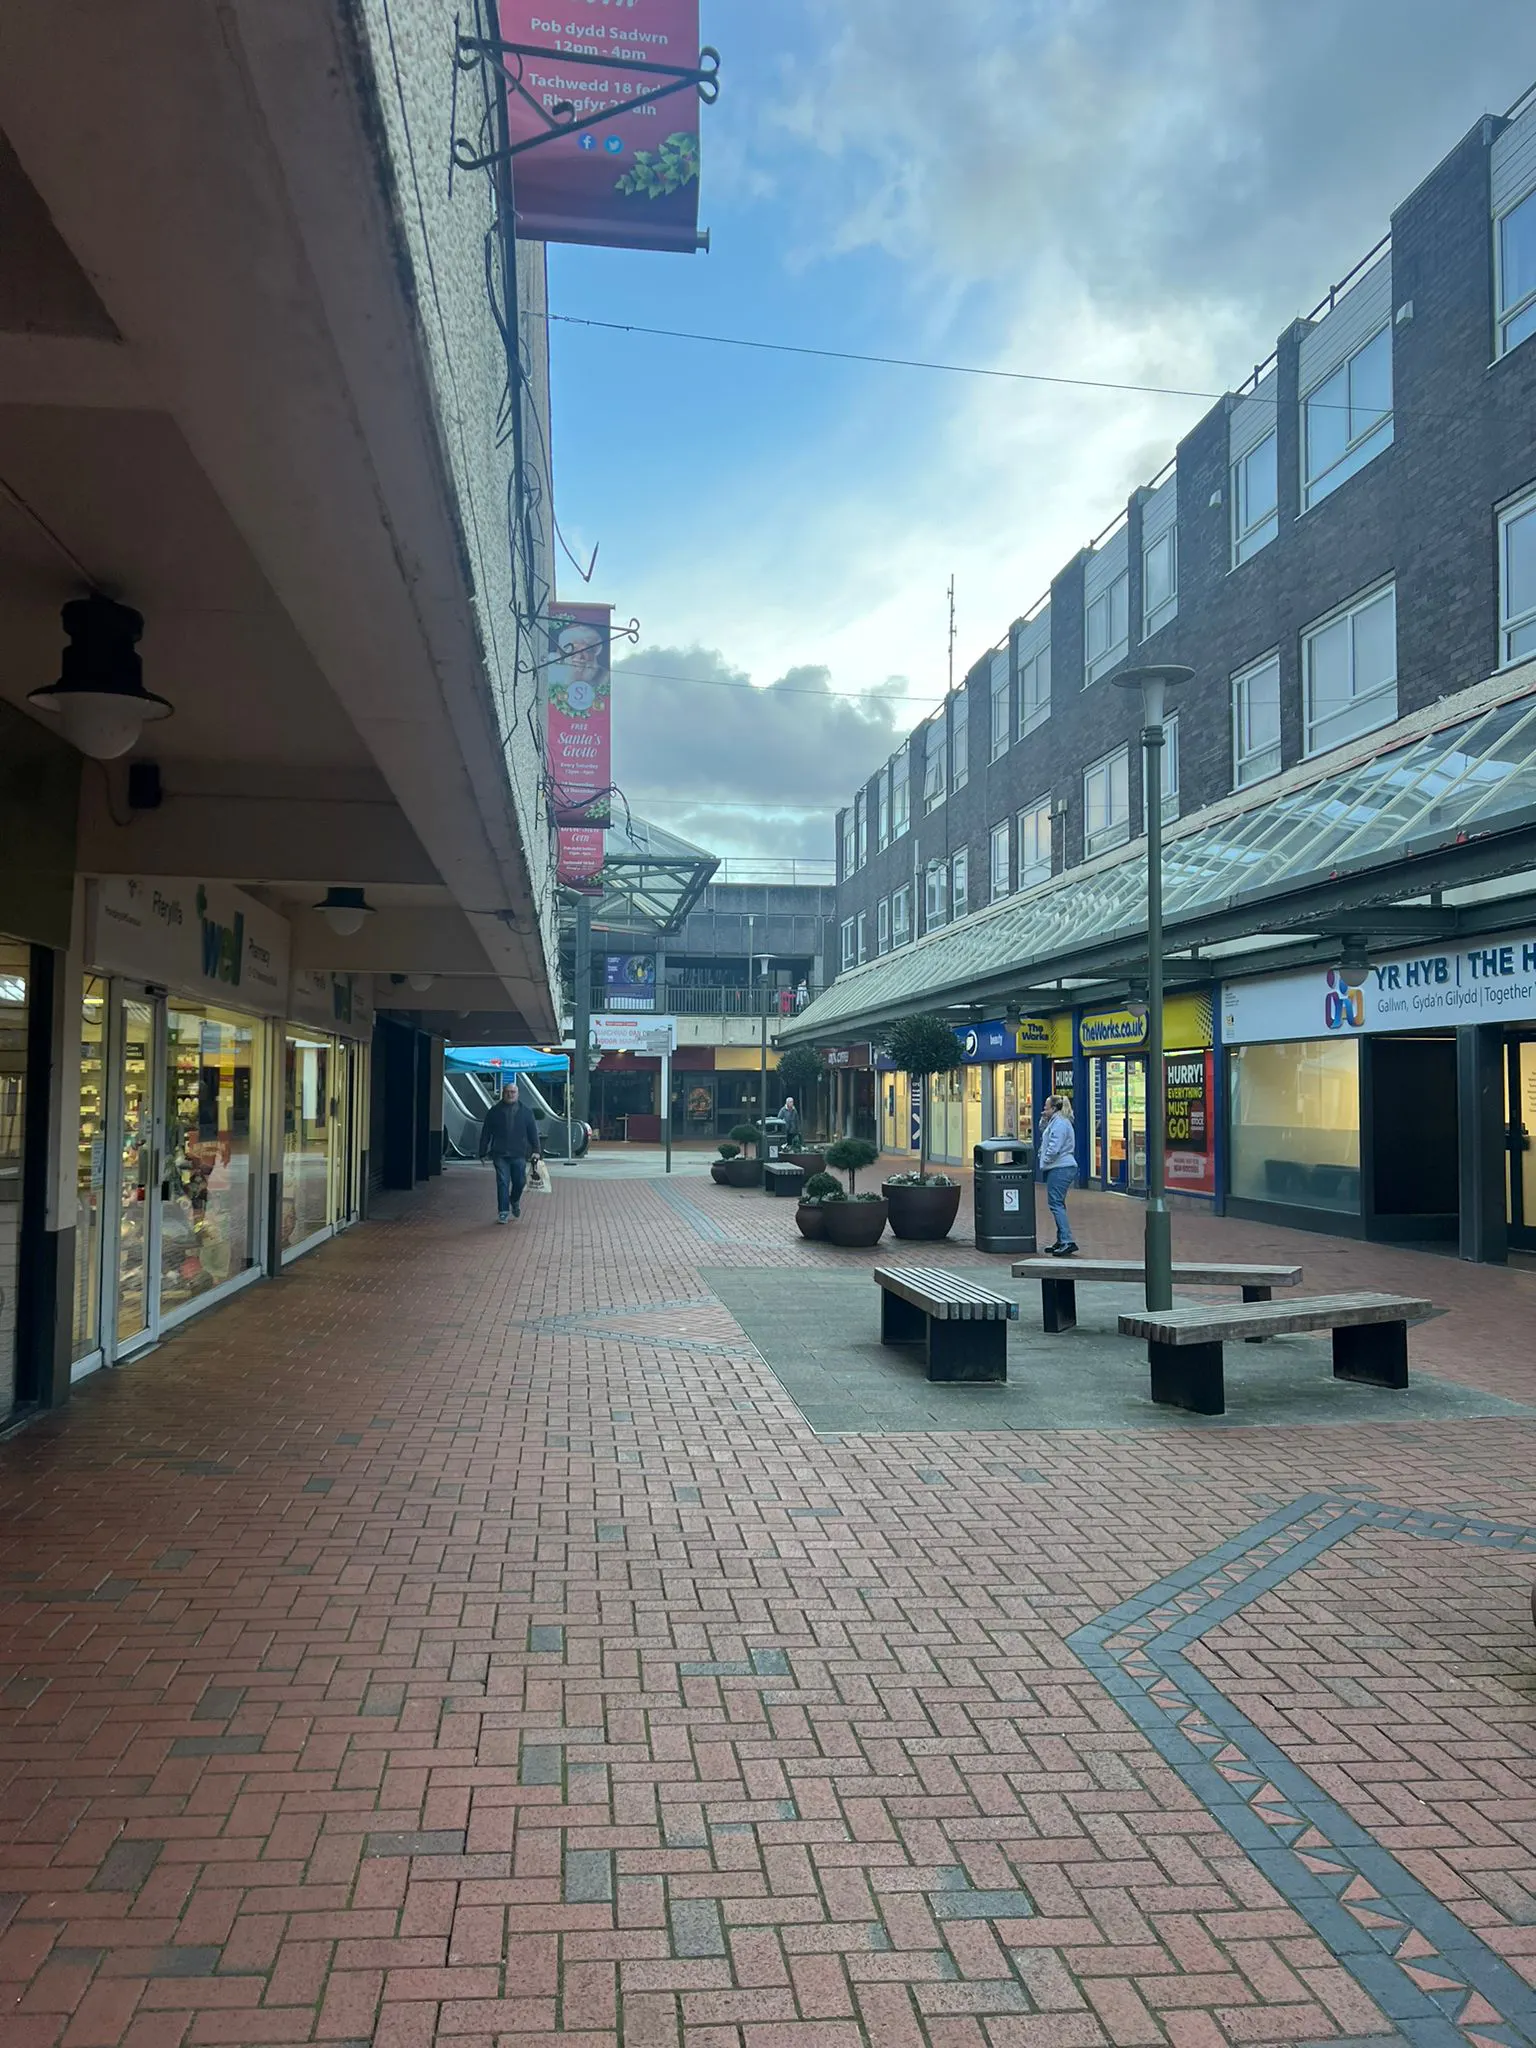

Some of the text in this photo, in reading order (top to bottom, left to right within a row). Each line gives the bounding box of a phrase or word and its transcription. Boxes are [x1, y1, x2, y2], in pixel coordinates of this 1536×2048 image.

[531, 18, 668, 45] Pob dydd Sadwrn
[611, 46, 646, 62] 4pm
[529, 73, 608, 92] Tachwedd
[614, 82, 632, 94] 18
[558, 732, 601, 745] Santa's
[563, 745, 597, 758] Grotto
[1375, 965, 1402, 991] YR
[1406, 956, 1449, 987] HYB
[1468, 947, 1515, 979] THE
[1377, 999, 1409, 1014] Gallwn,
[1412, 993, 1444, 1012] Gyda'n
[1447, 988, 1478, 1007] Gilydd
[1485, 983, 1532, 1004] Together
[1022, 1031, 1049, 1042] Works
[1027, 1023, 1044, 1033] The
[1082, 1017, 1144, 1042] TheWorks.co.uk
[1167, 1063, 1204, 1085] HURRY!
[1167, 1086, 1203, 1100] EVERYTHING
[1168, 1101, 1189, 1117] MUST
[1168, 1118, 1190, 1140] GO!
